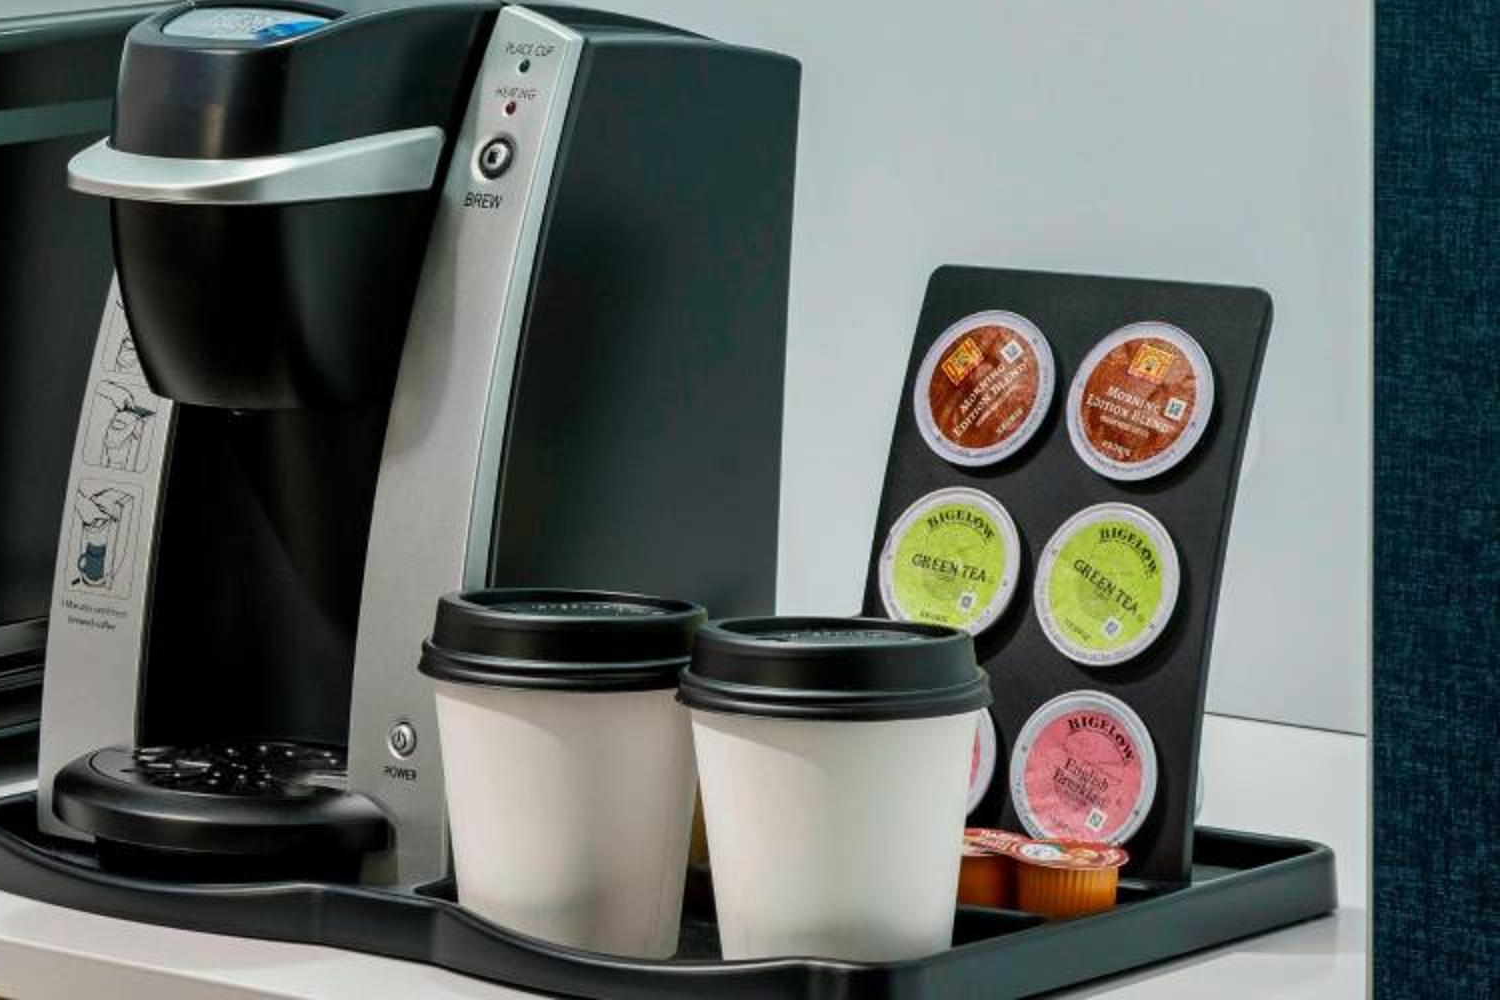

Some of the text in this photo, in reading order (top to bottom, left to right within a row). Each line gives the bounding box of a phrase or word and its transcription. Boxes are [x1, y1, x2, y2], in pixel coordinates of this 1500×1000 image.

[464, 191, 503, 209] BREW
[926, 509, 995, 541] BIGELOW
[1099, 527, 1157, 575] BIGELOW
[911, 553, 987, 583] GREEN TEA
[1073, 558, 1138, 616] GREEN TEA
[1067, 716, 1135, 762] BIGELOW
[383, 765, 417, 781] POWER
